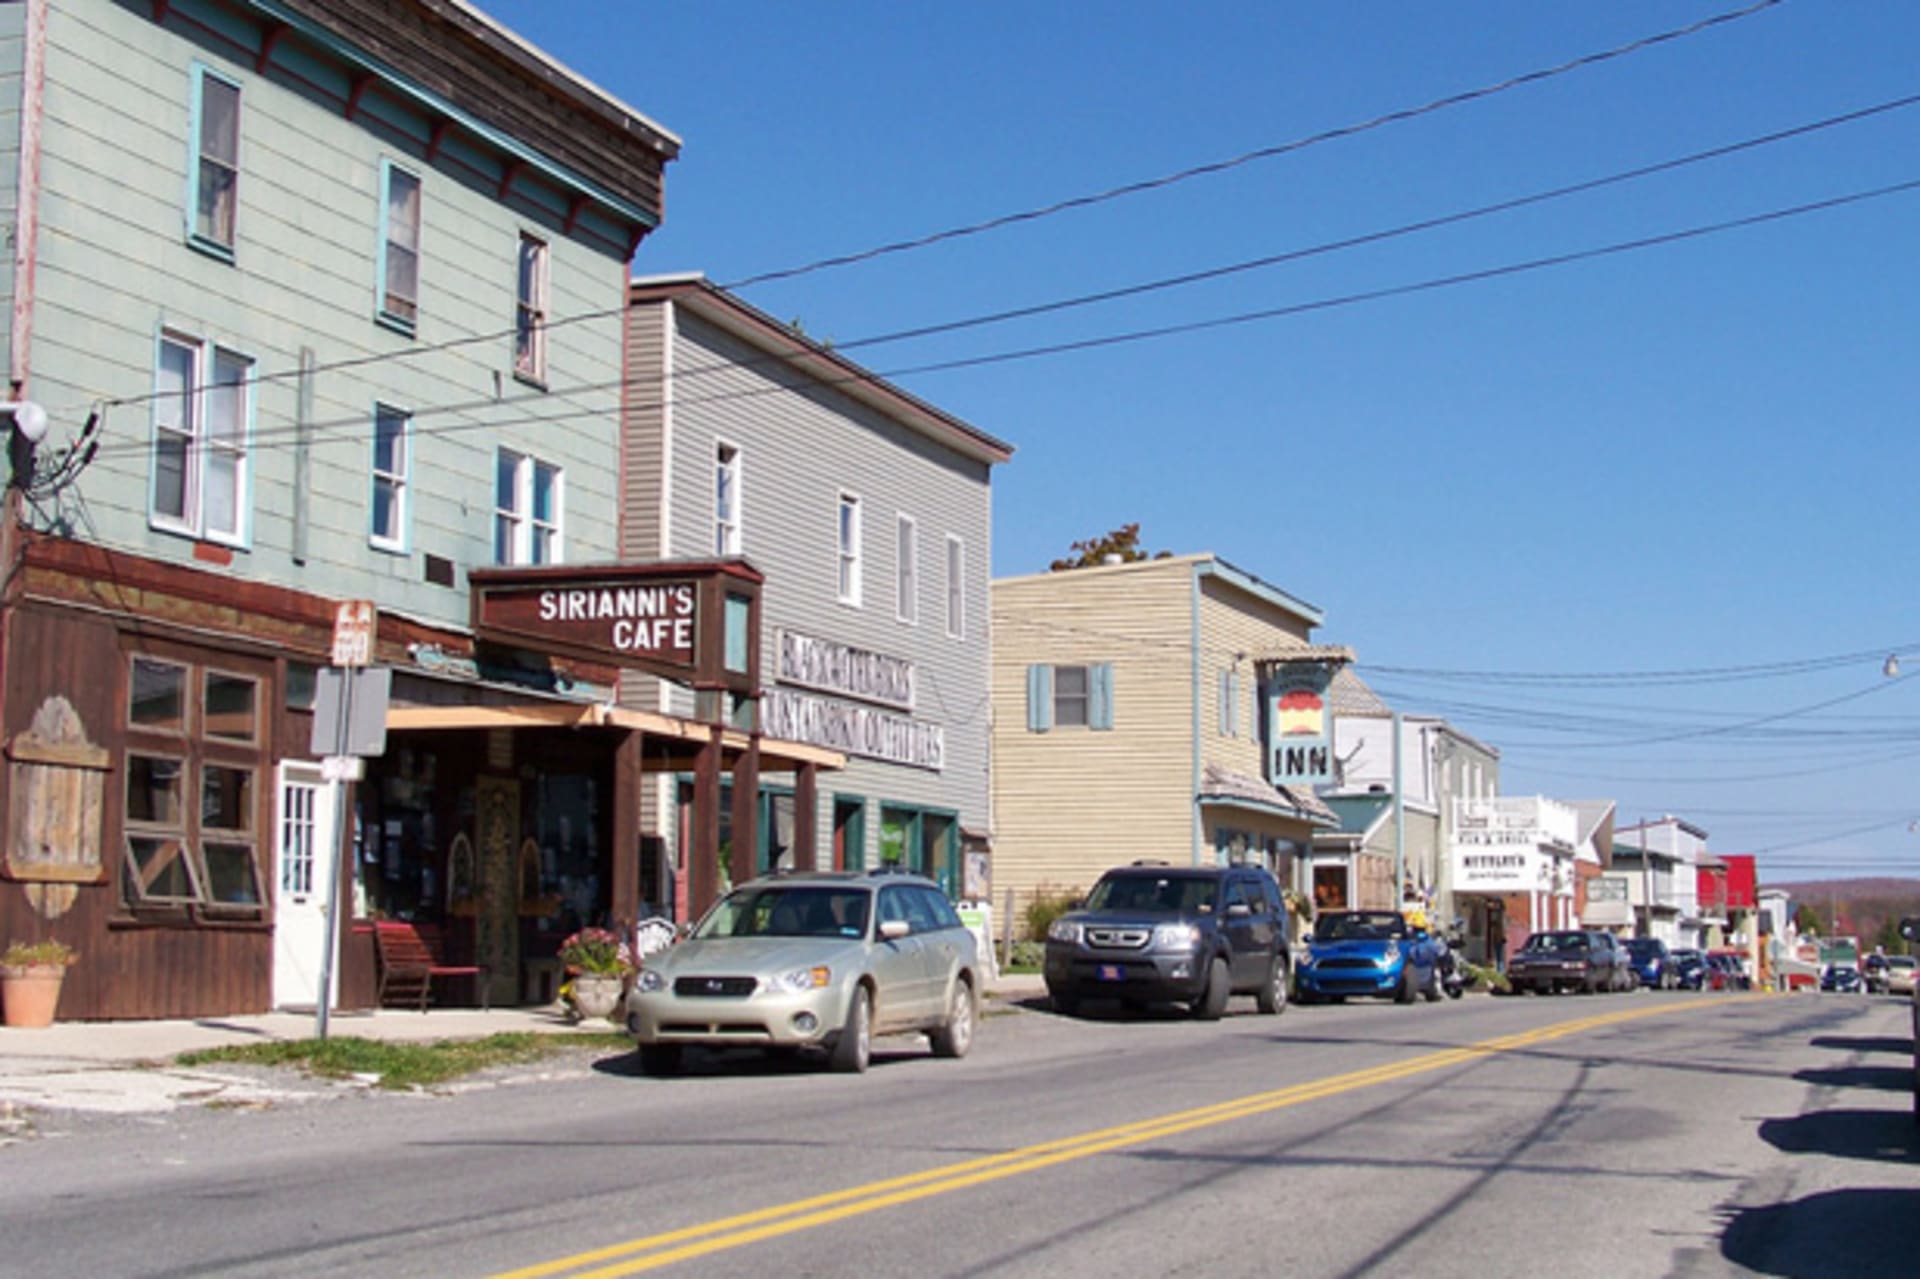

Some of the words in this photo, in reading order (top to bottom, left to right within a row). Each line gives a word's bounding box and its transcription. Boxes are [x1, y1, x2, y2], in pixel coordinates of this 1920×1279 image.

[540, 587, 693, 620] SIRIANNI'S
[613, 619, 693, 649] CAFE
[1275, 746, 1327, 776] INN
